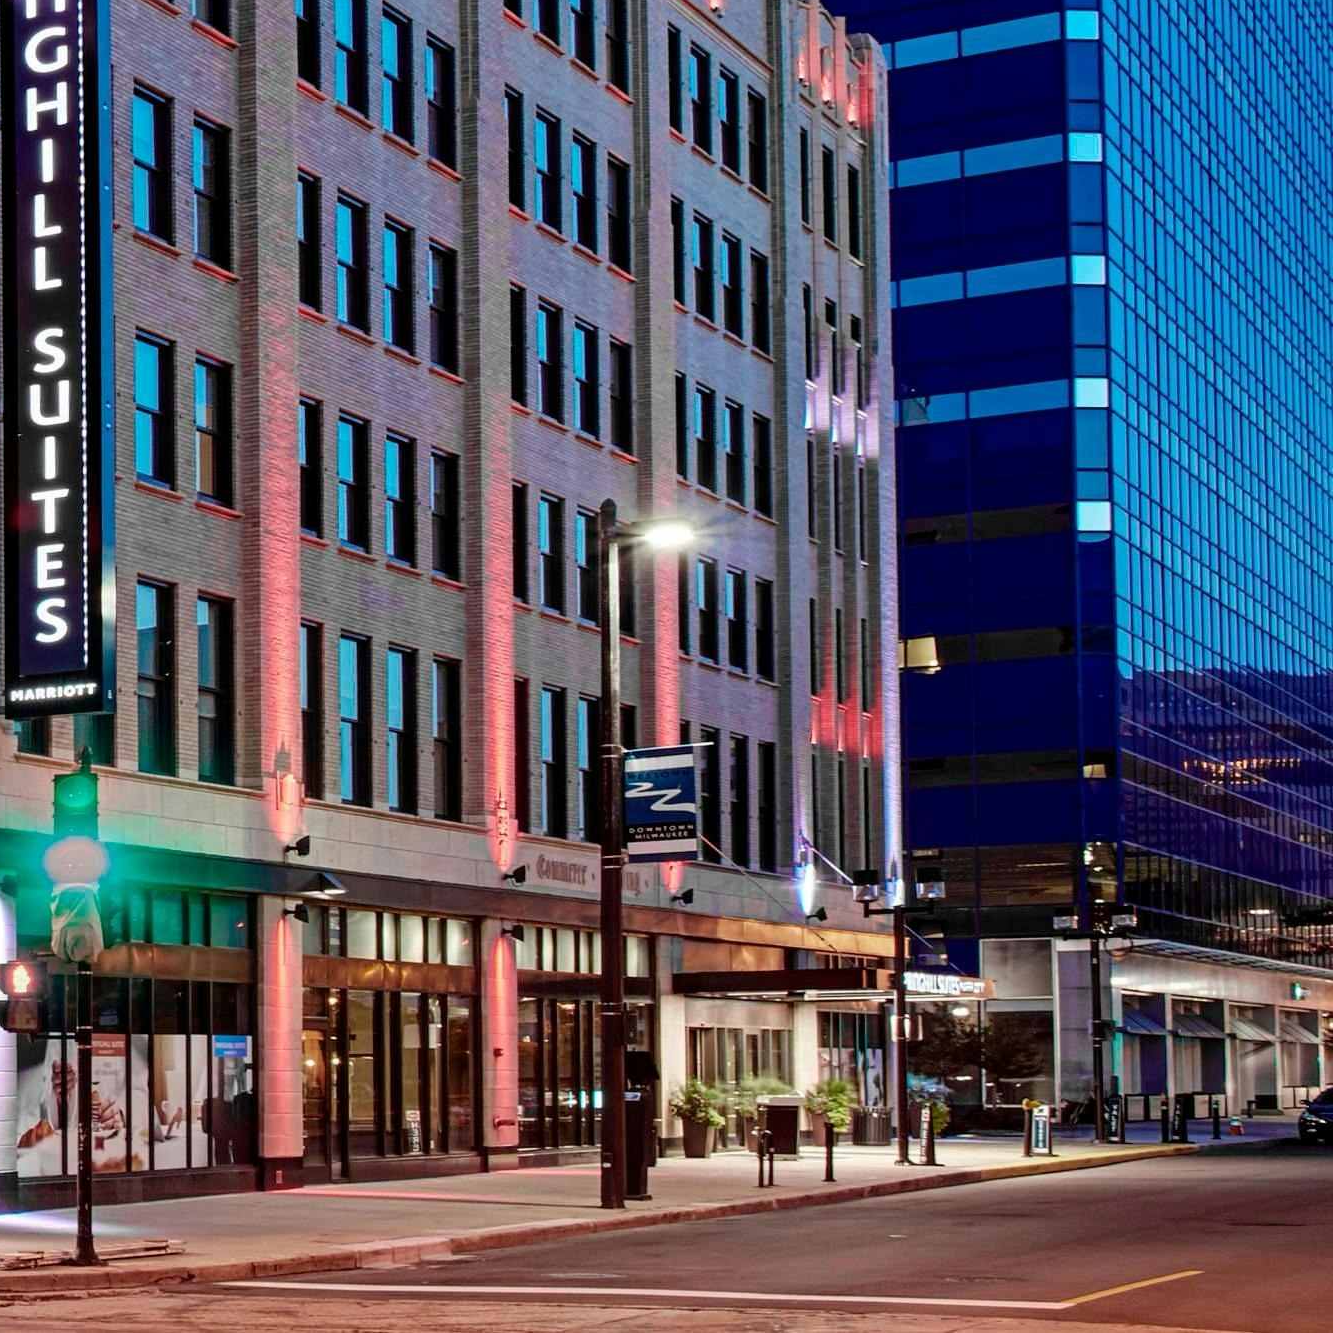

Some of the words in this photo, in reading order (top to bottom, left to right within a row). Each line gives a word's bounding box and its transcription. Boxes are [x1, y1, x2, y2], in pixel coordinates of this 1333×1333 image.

[29, 327, 70, 643] SUITES
[10, 682, 97, 702] MARRIOTT
[629, 824, 694, 834] DOWNTOWN
[635, 830, 688, 839] MILWAUKEE
